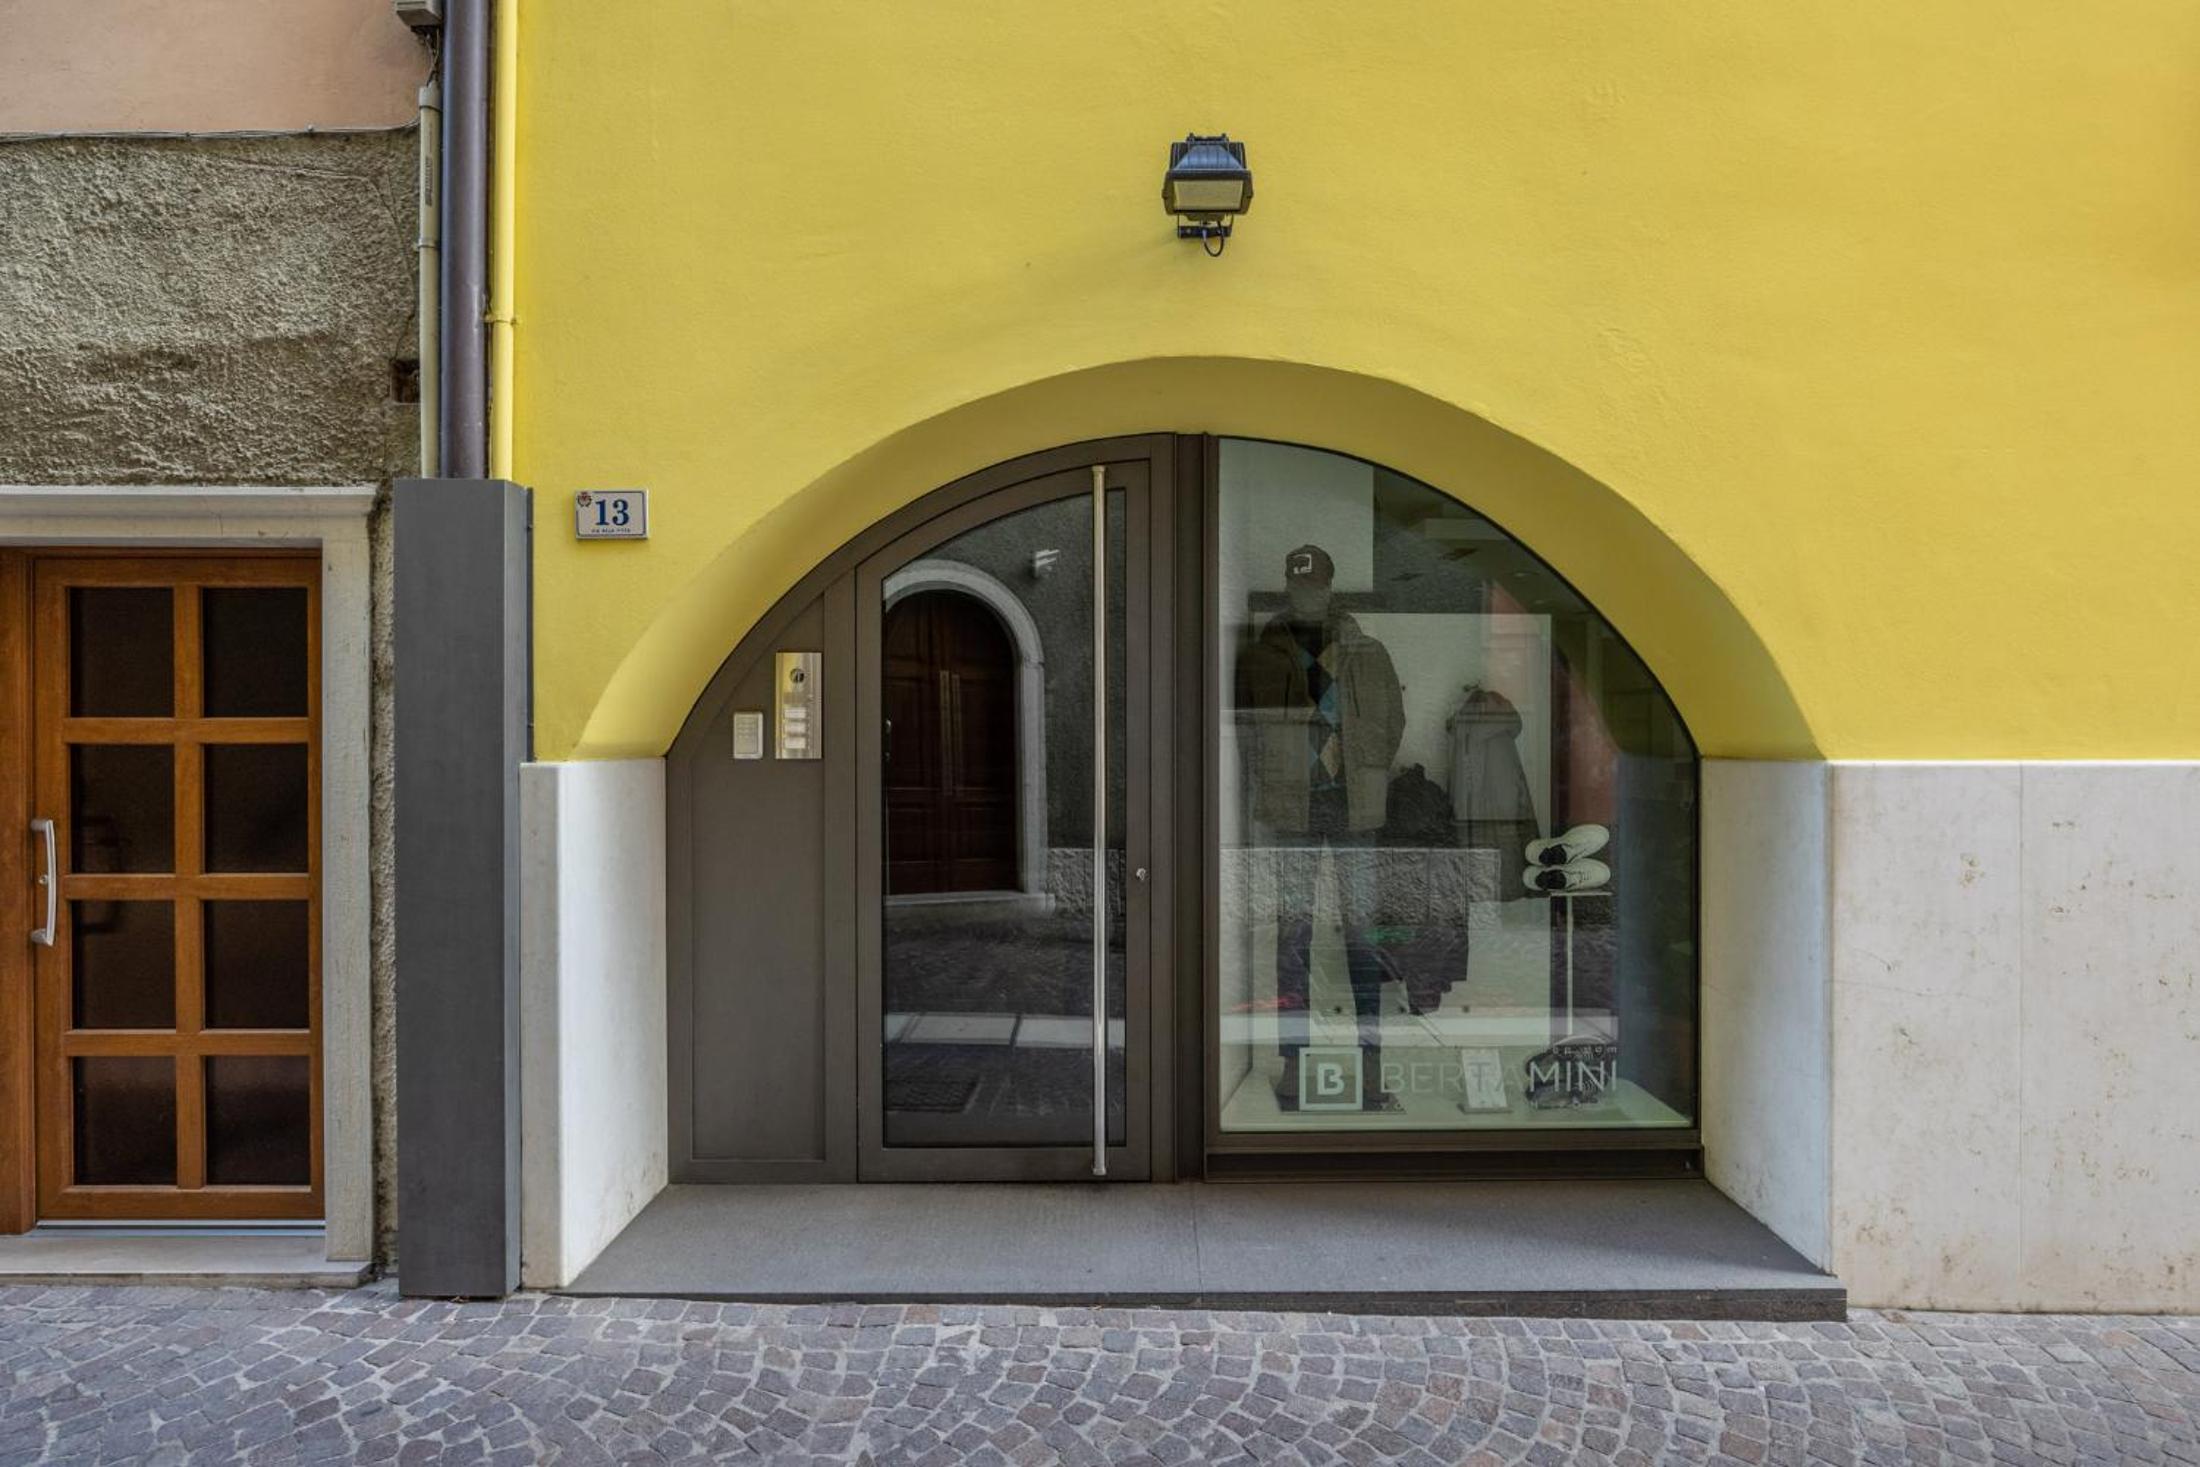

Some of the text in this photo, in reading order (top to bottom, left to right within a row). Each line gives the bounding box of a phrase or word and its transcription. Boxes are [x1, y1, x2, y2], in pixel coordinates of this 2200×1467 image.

[594, 498, 631, 527] 13
[1316, 1060, 1618, 1095] B BERTAMINI
